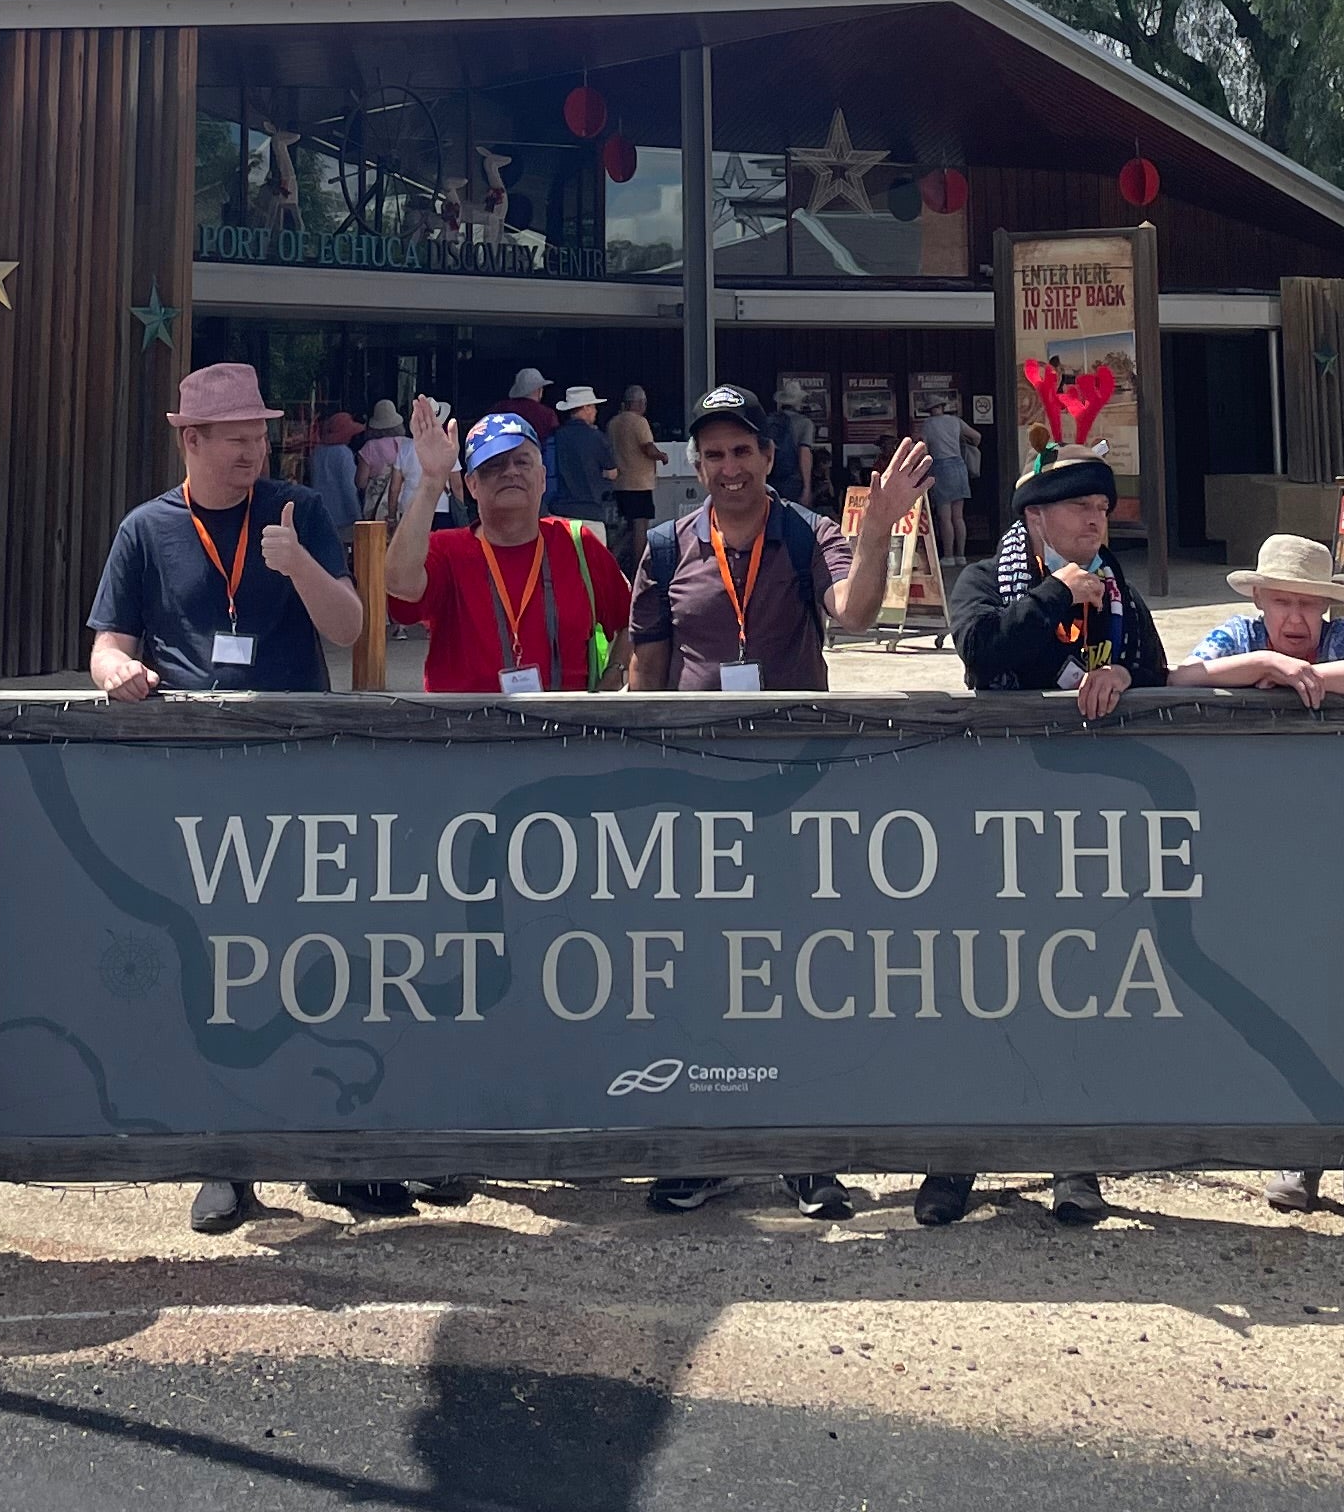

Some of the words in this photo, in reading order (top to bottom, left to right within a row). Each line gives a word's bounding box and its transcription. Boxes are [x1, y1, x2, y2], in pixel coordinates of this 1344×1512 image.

[199, 224, 271, 262] PORT
[278, 231, 310, 263] OF
[319, 233, 422, 270] ECHUCA
[427, 240, 538, 273] DISCOVERY
[544, 245, 608, 278] CENTR
[1022, 264, 1069, 286] ENTER
[1072, 263, 1112, 284] HERE
[1022, 287, 1041, 308] TO
[1044, 286, 1081, 307] STEP
[1085, 285, 1126, 306] BACK
[1023, 309, 1038, 330] IN
[1041, 309, 1078, 329] TIME
[174, 811, 755, 905] WELCOME
[791, 809, 940, 899] TO
[975, 809, 1203, 899] THE
[207, 931, 505, 1025] PORT
[542, 930, 685, 1021] OF
[722, 928, 1184, 1021] ECHUCA
[687, 1065, 778, 1082] Campaspe
[689, 1082, 713, 1092] Shire
[714, 1082, 749, 1092] Council
